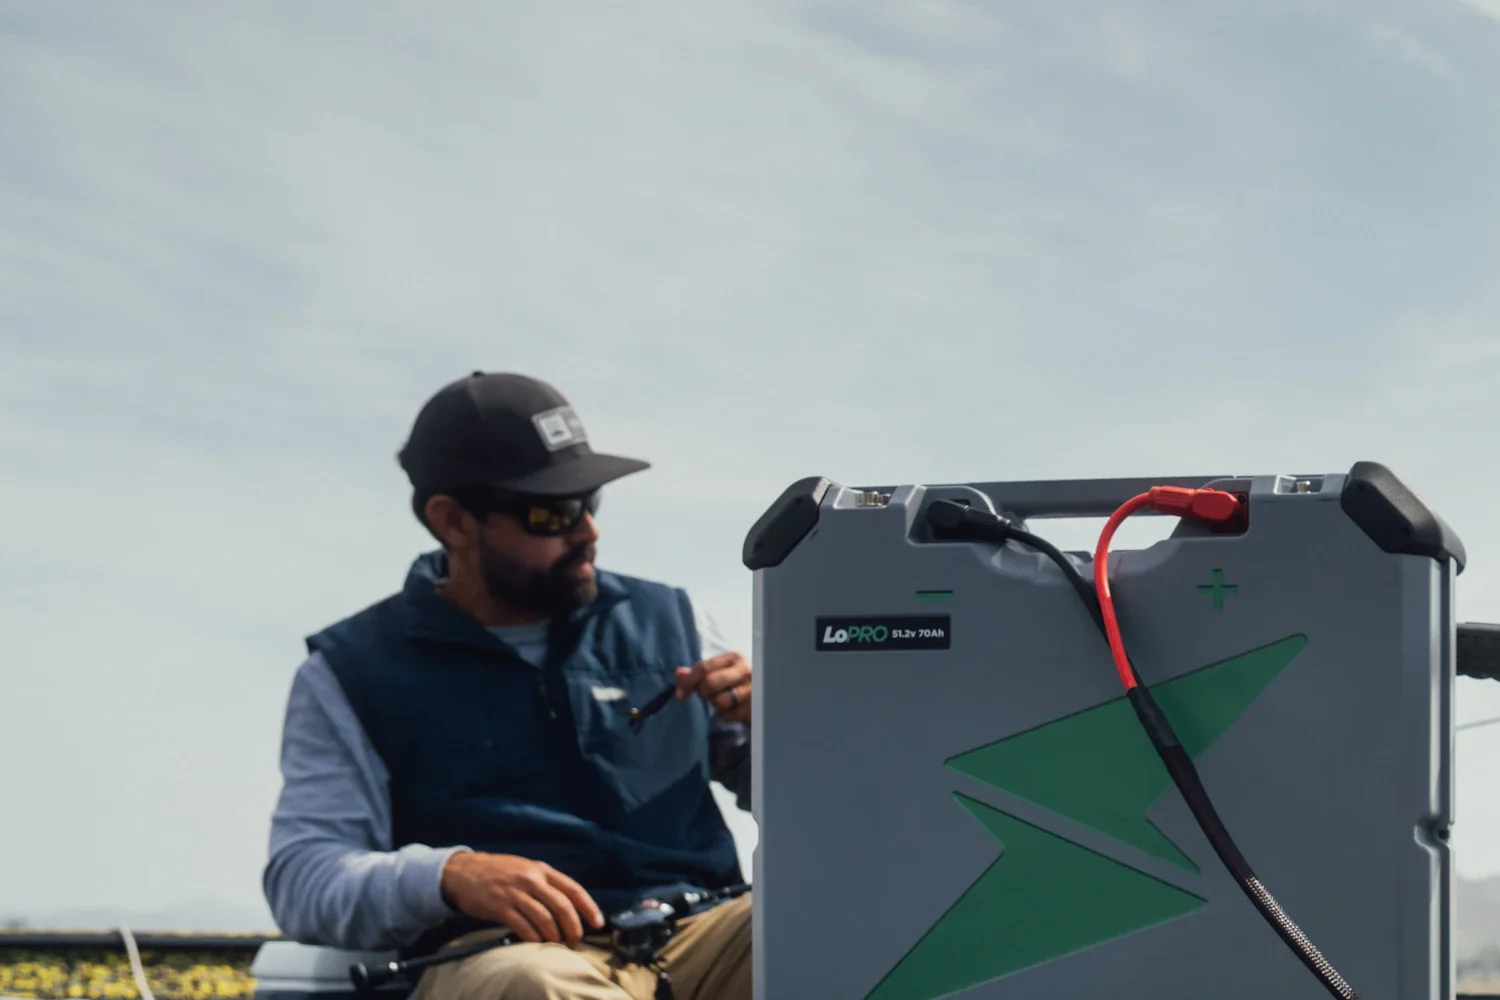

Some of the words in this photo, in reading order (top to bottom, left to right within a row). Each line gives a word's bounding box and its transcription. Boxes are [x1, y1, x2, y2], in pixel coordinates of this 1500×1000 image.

[823, 625, 888, 643] LoPRO
[892, 629, 916, 638] 51.2v
[918, 628, 944, 638] 70Ah
